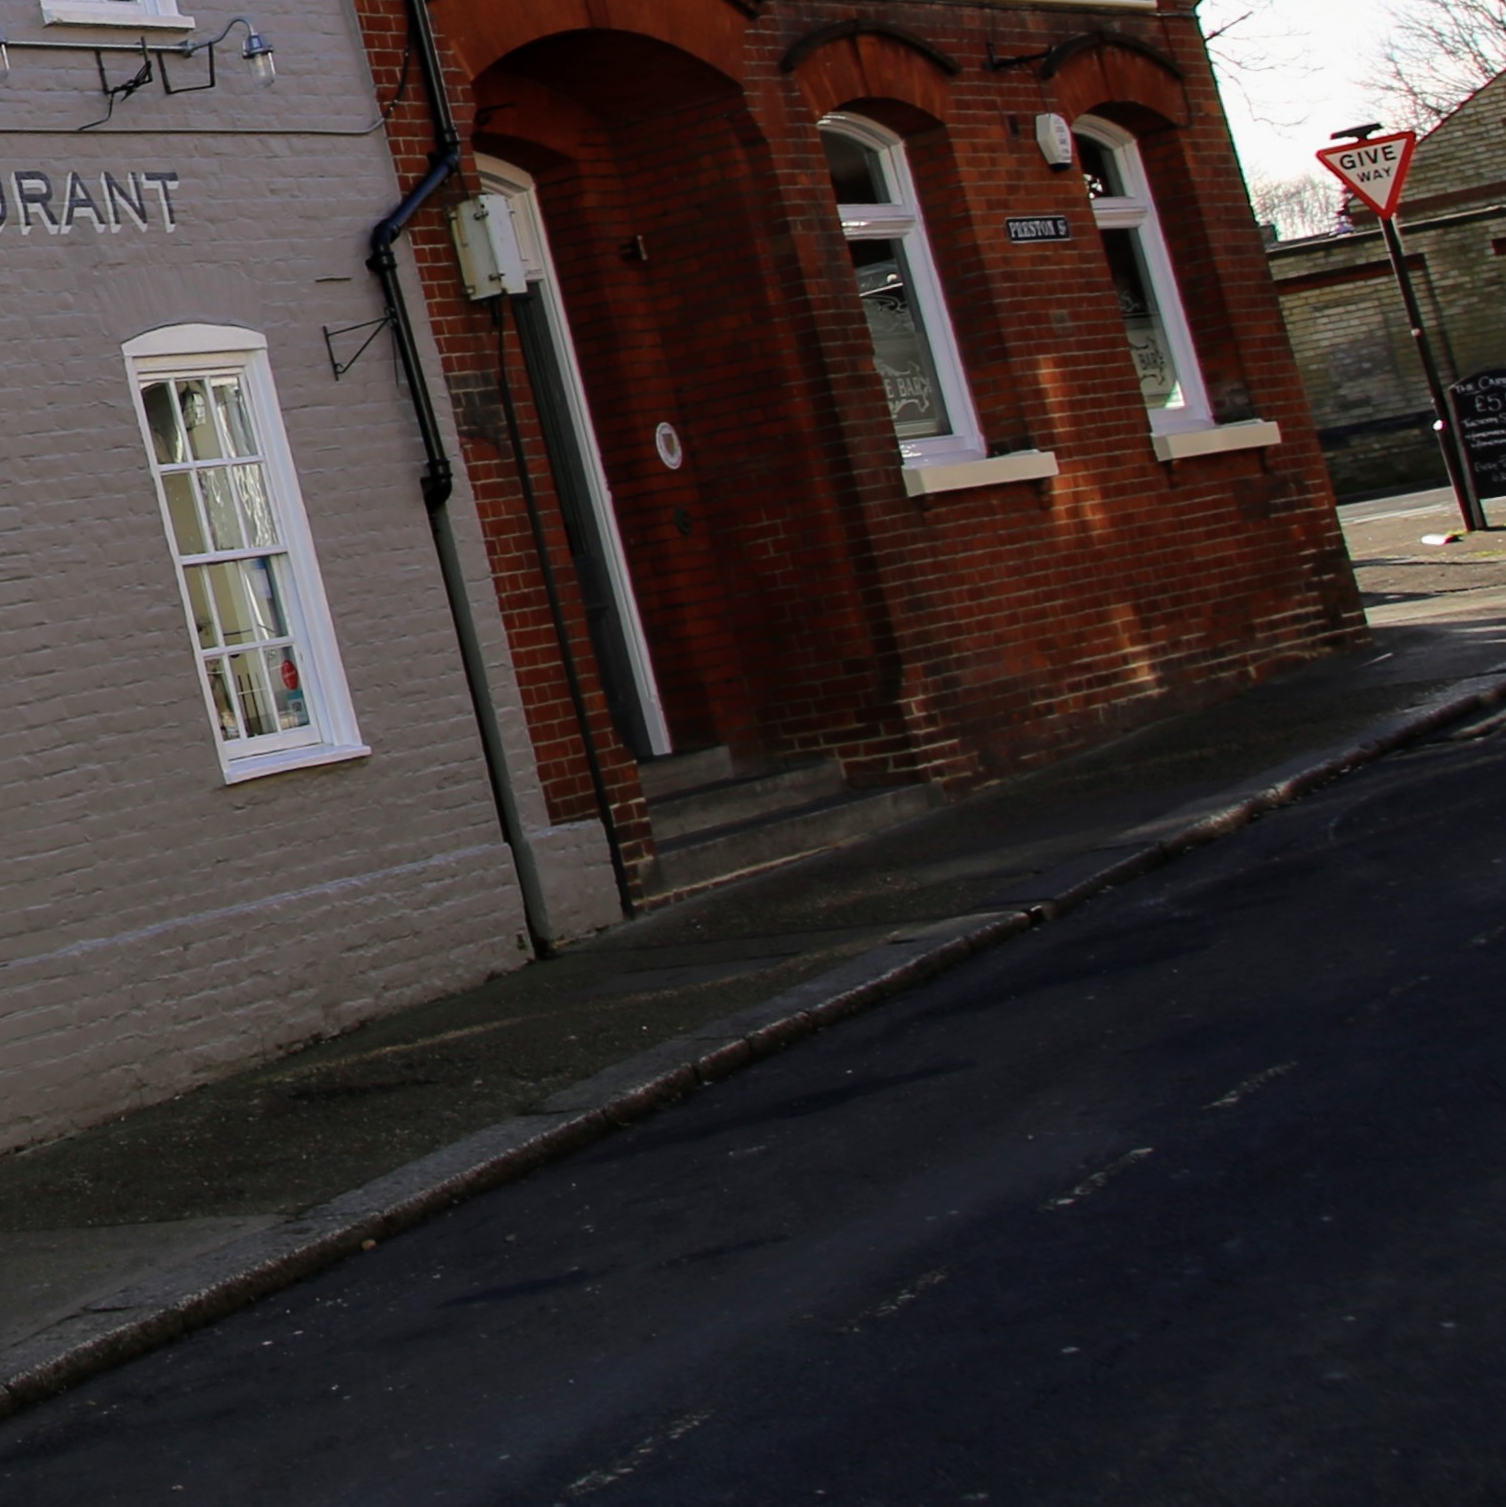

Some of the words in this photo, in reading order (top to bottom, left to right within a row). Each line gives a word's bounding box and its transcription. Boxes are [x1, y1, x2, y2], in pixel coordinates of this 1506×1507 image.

[1340, 145, 1397, 170] GIVE
[1357, 167, 1391, 183] WAY
[1008, 220, 1056, 238] PRESTON
